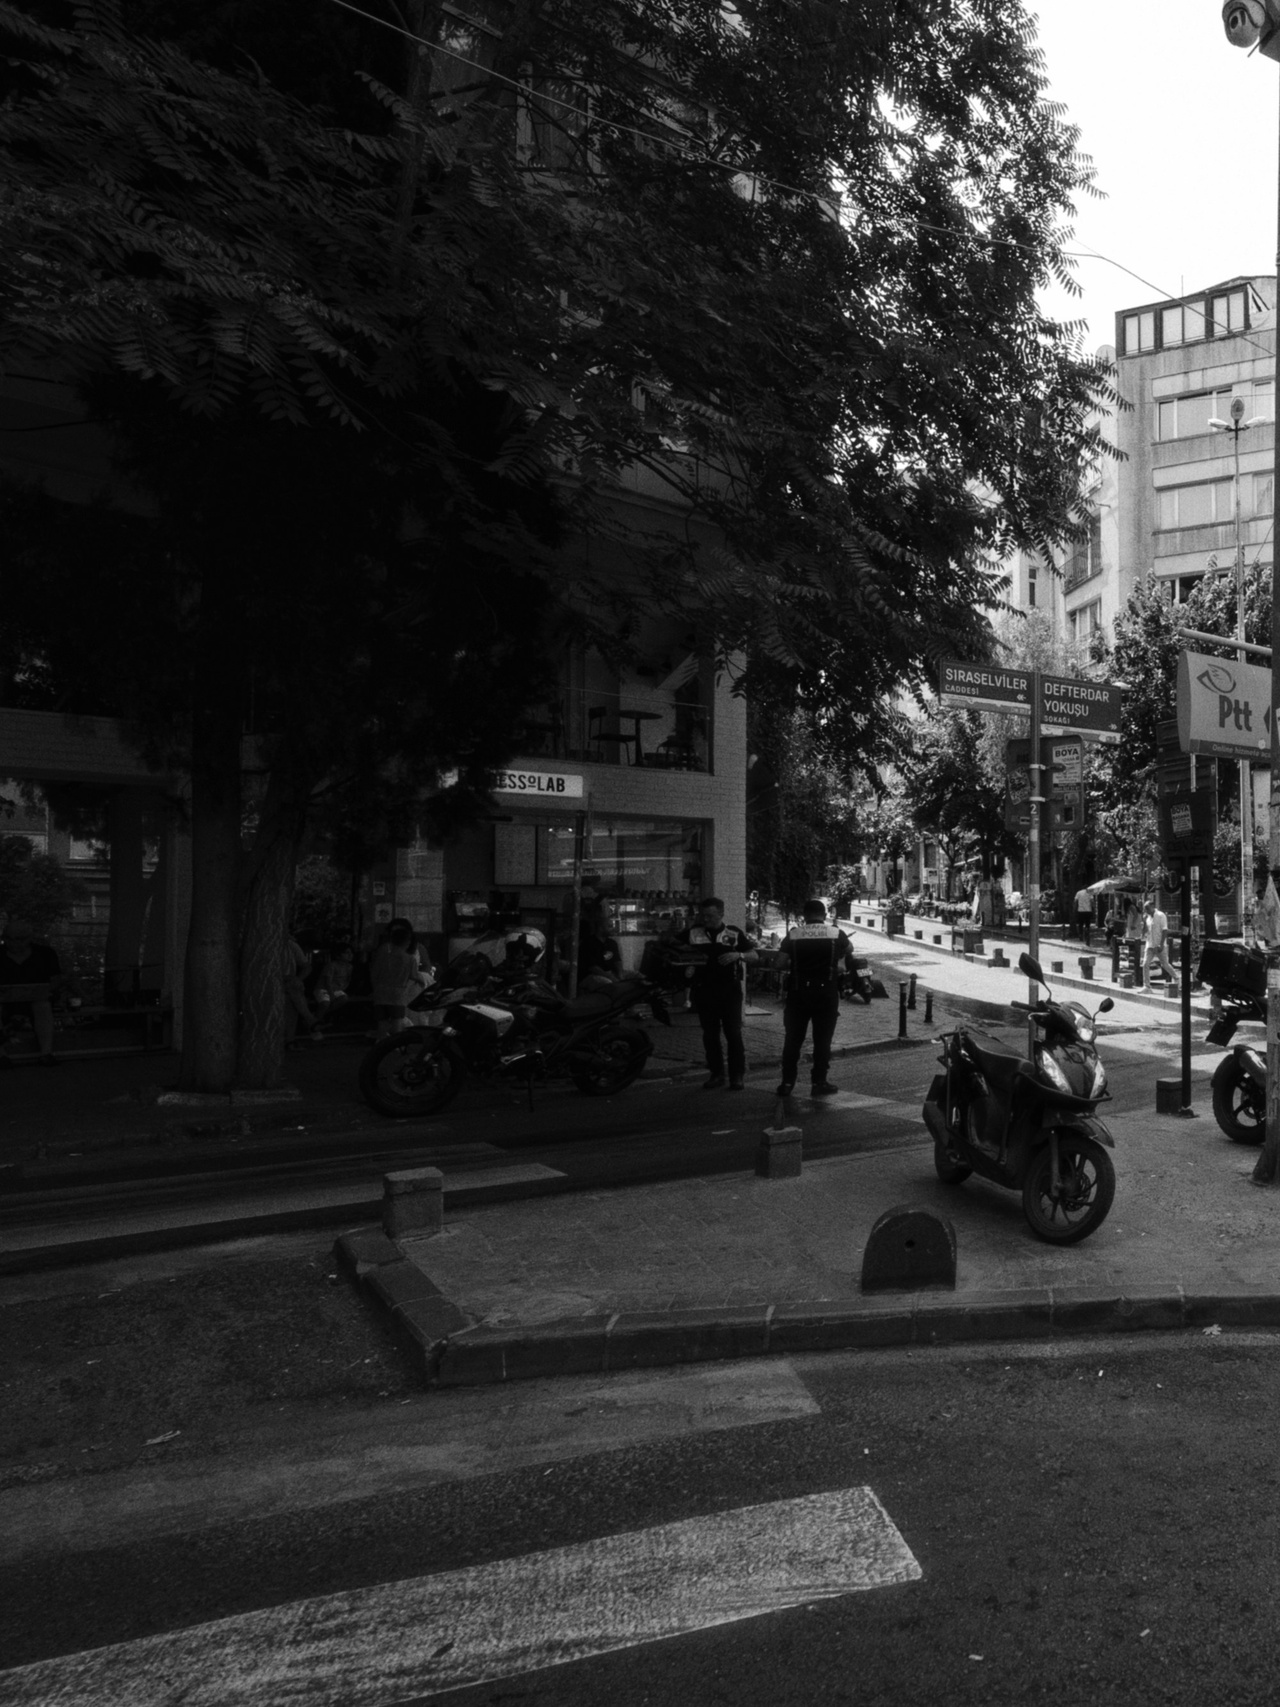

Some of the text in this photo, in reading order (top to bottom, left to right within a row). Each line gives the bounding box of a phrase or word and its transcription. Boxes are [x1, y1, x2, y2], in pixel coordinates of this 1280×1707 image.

[945, 667, 1028, 691] SIRASELVİLER
[1044, 682, 1110, 703] DEFTERDAR
[1043, 699, 1089, 718] YOKUŞU
[1218, 694, 1253, 732] Ptt
[1043, 714, 1071, 725] SOKAĞI
[1055, 747, 1079, 758] BOYA
[1030, 803, 1038, 815] 2
